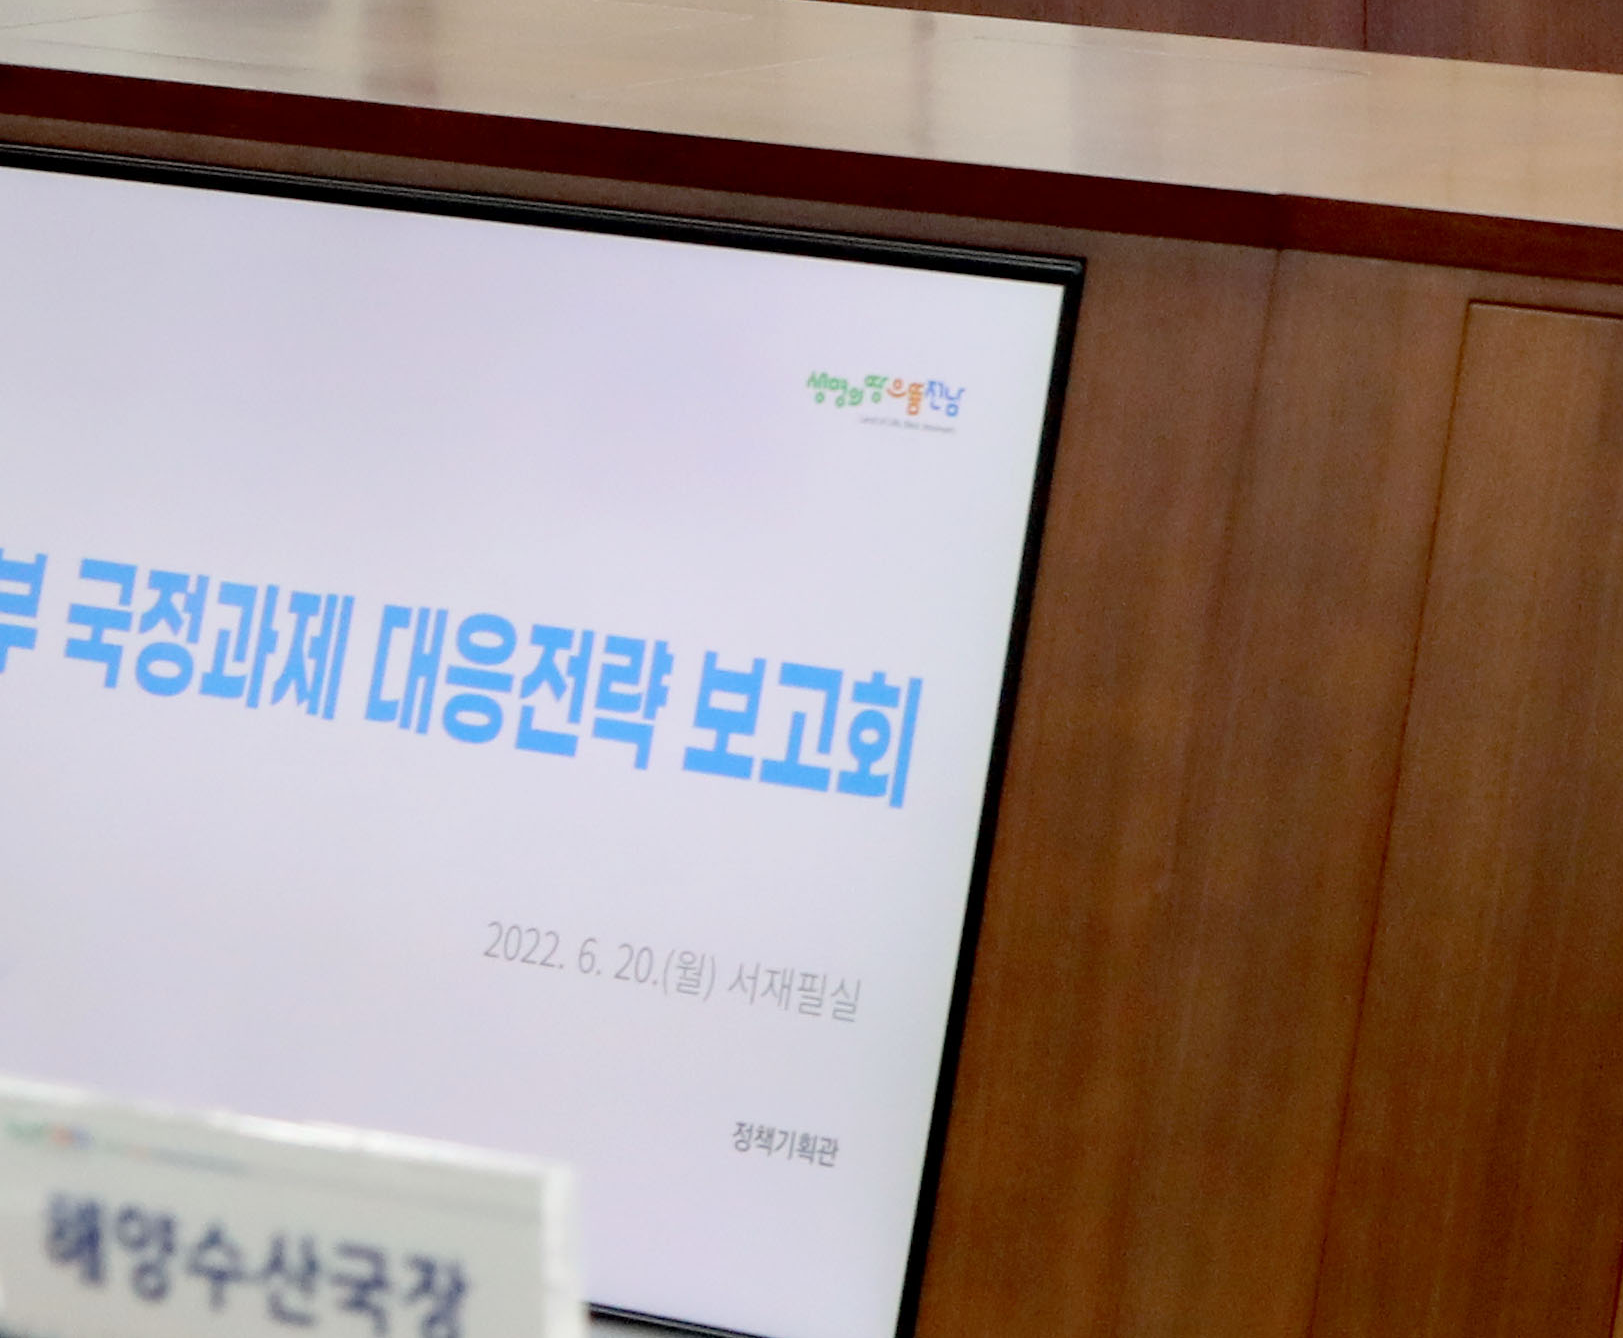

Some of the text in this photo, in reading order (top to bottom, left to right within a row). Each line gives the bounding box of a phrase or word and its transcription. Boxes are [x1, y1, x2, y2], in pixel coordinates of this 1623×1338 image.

[64, 557, 356, 722] 국정과제
[365, 604, 675, 772] 대응전략
[682, 648, 924, 809] 보고회
[482, 919, 565, 970] 2022.
[577, 936, 602, 977] 6.
[727, 962, 863, 1024] 서재필실
[730, 1119, 841, 1169] 정책기획관
